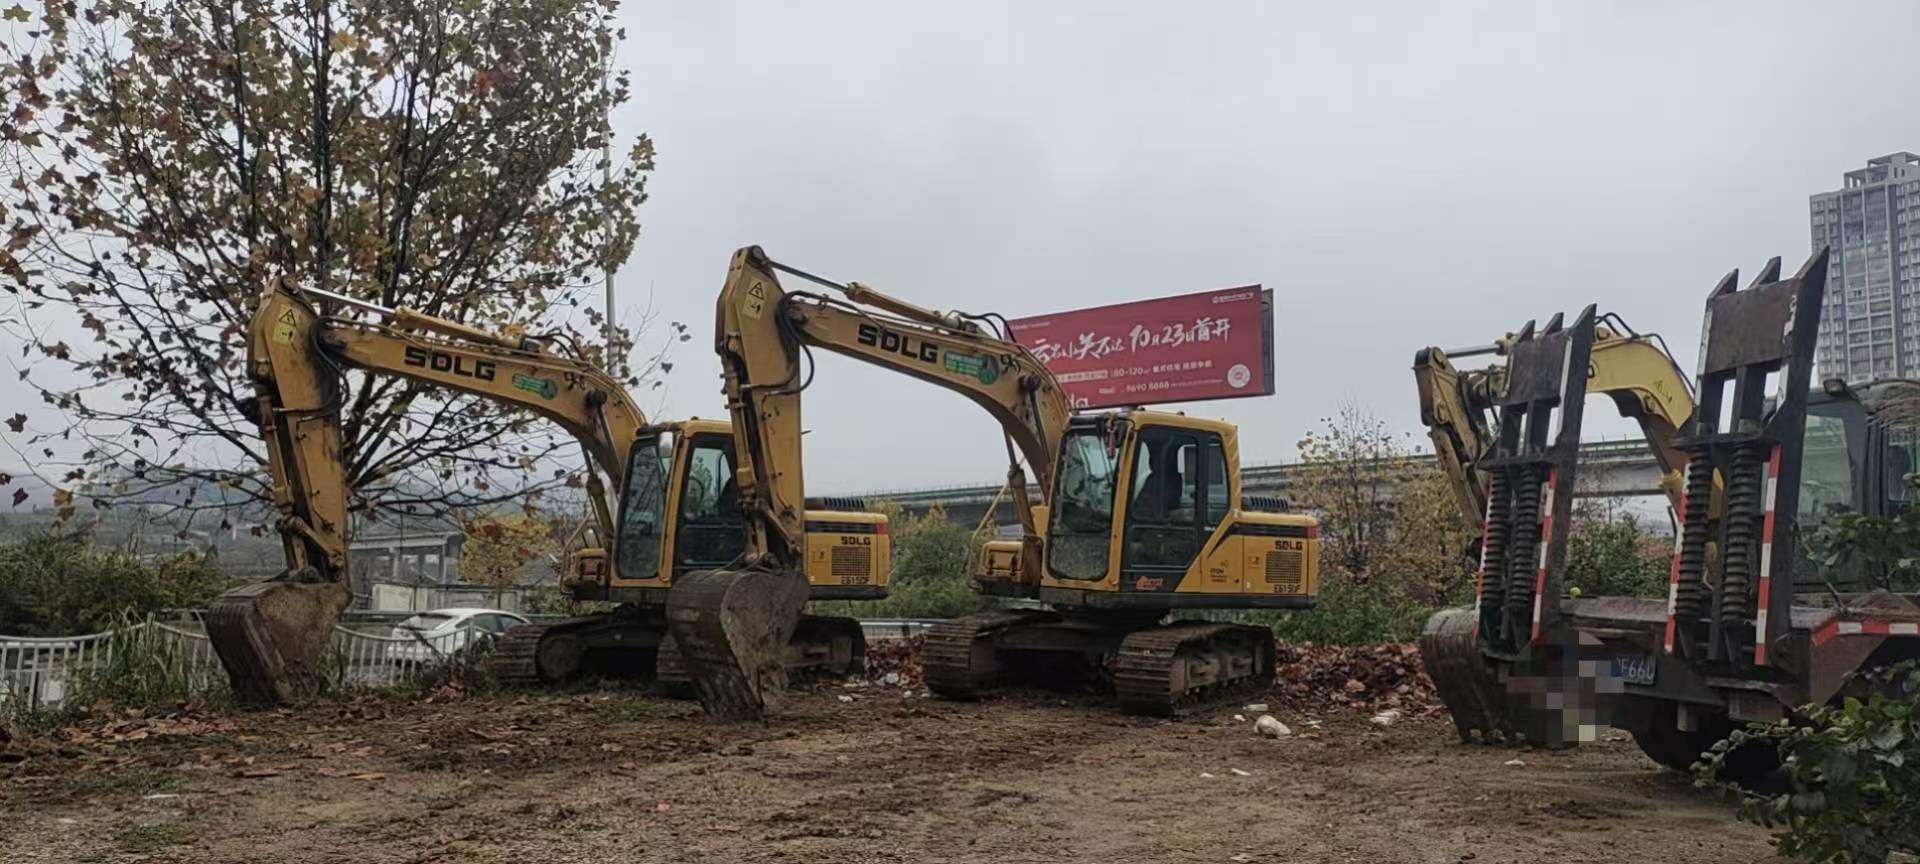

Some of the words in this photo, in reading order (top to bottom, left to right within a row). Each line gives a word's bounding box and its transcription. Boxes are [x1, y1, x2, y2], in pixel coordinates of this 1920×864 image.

[858, 324, 938, 364] SDLG
[404, 345, 496, 381] SDLG
[841, 536, 872, 546] SDLG
[1275, 540, 1303, 550] SDLG
